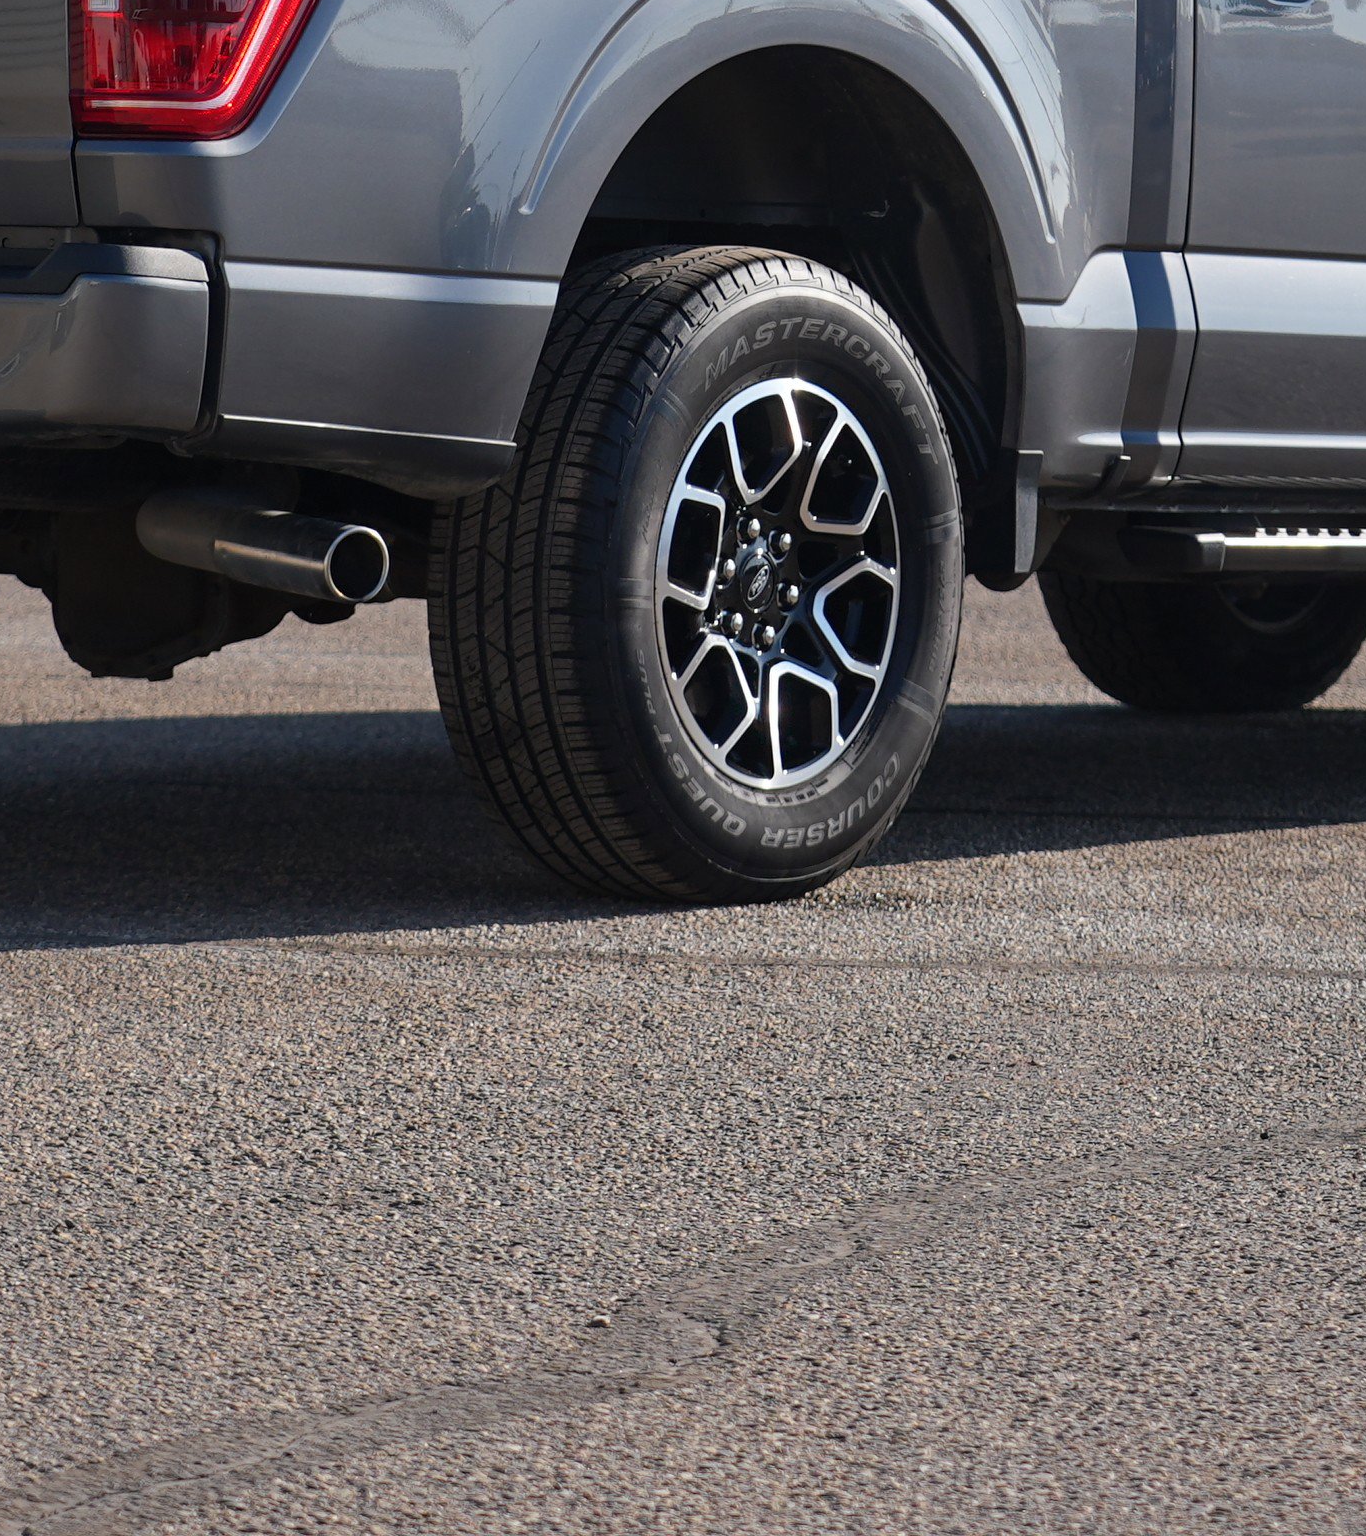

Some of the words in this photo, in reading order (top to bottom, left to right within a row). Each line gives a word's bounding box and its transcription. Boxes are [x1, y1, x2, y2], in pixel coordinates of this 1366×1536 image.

[704, 316, 939, 465] MASTERCRAFT
[635, 648, 657, 715] PLUS
[652, 723, 748, 838] QUEST
[760, 751, 902, 849] COURSER
